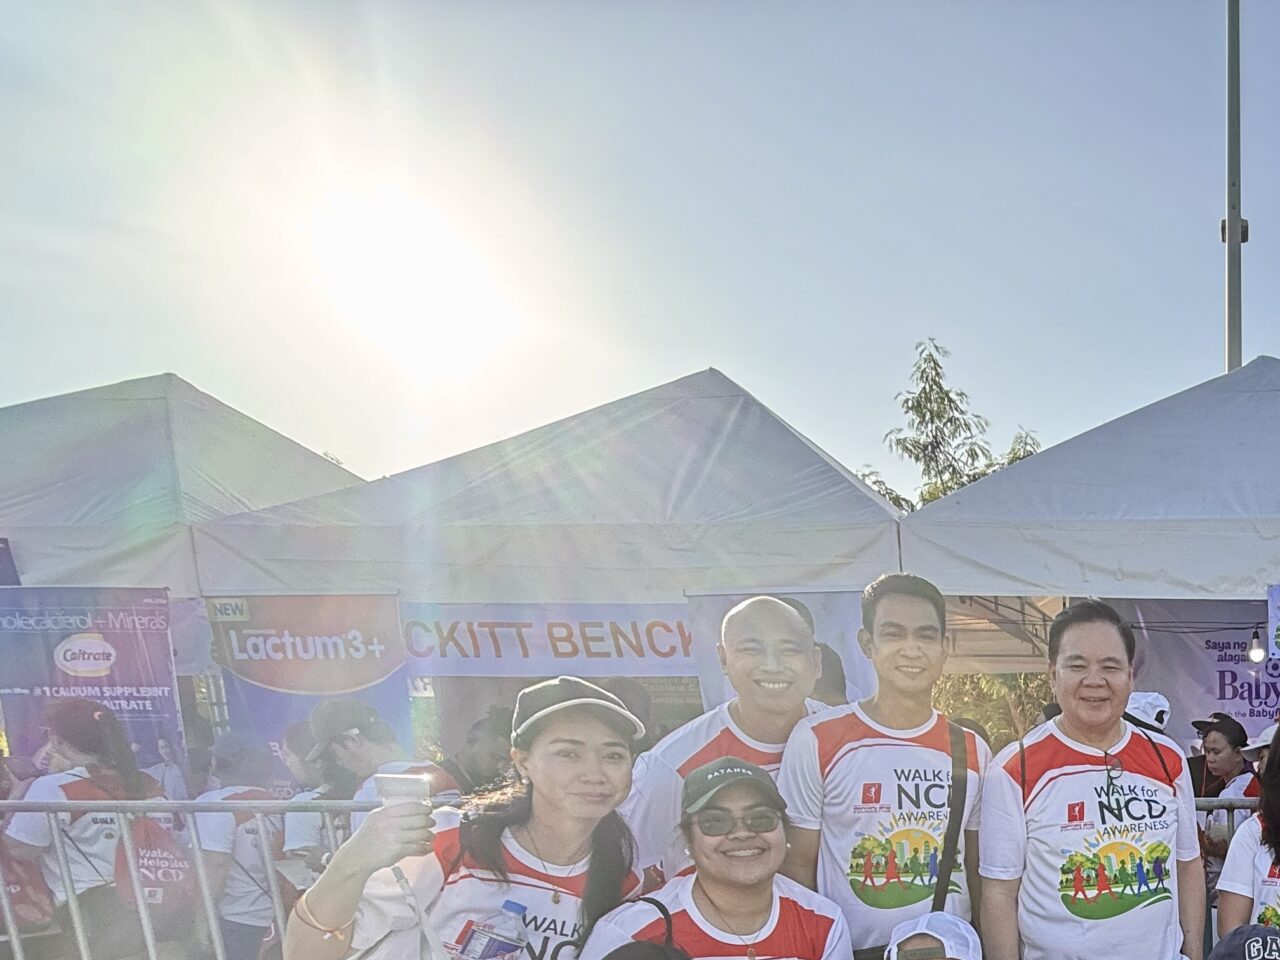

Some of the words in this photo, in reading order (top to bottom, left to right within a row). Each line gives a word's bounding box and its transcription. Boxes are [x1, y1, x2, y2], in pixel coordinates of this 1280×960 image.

[213, 603, 245, 617] NEW
[229, 630, 344, 661] Lactum
[348, 630, 386, 660] 3+
[1205, 640, 1233, 652] Saya
[63, 649, 113, 662] Caltrate
[102, 700, 152, 710] ALTRATE
[894, 769, 942, 782] WALK
[897, 783, 952, 810] NC
[1094, 784, 1139, 798] WALK
[1141, 786, 1158, 798] for
[1098, 797, 1167, 825] NCD
[1102, 820, 1169, 837] AWARENESS
